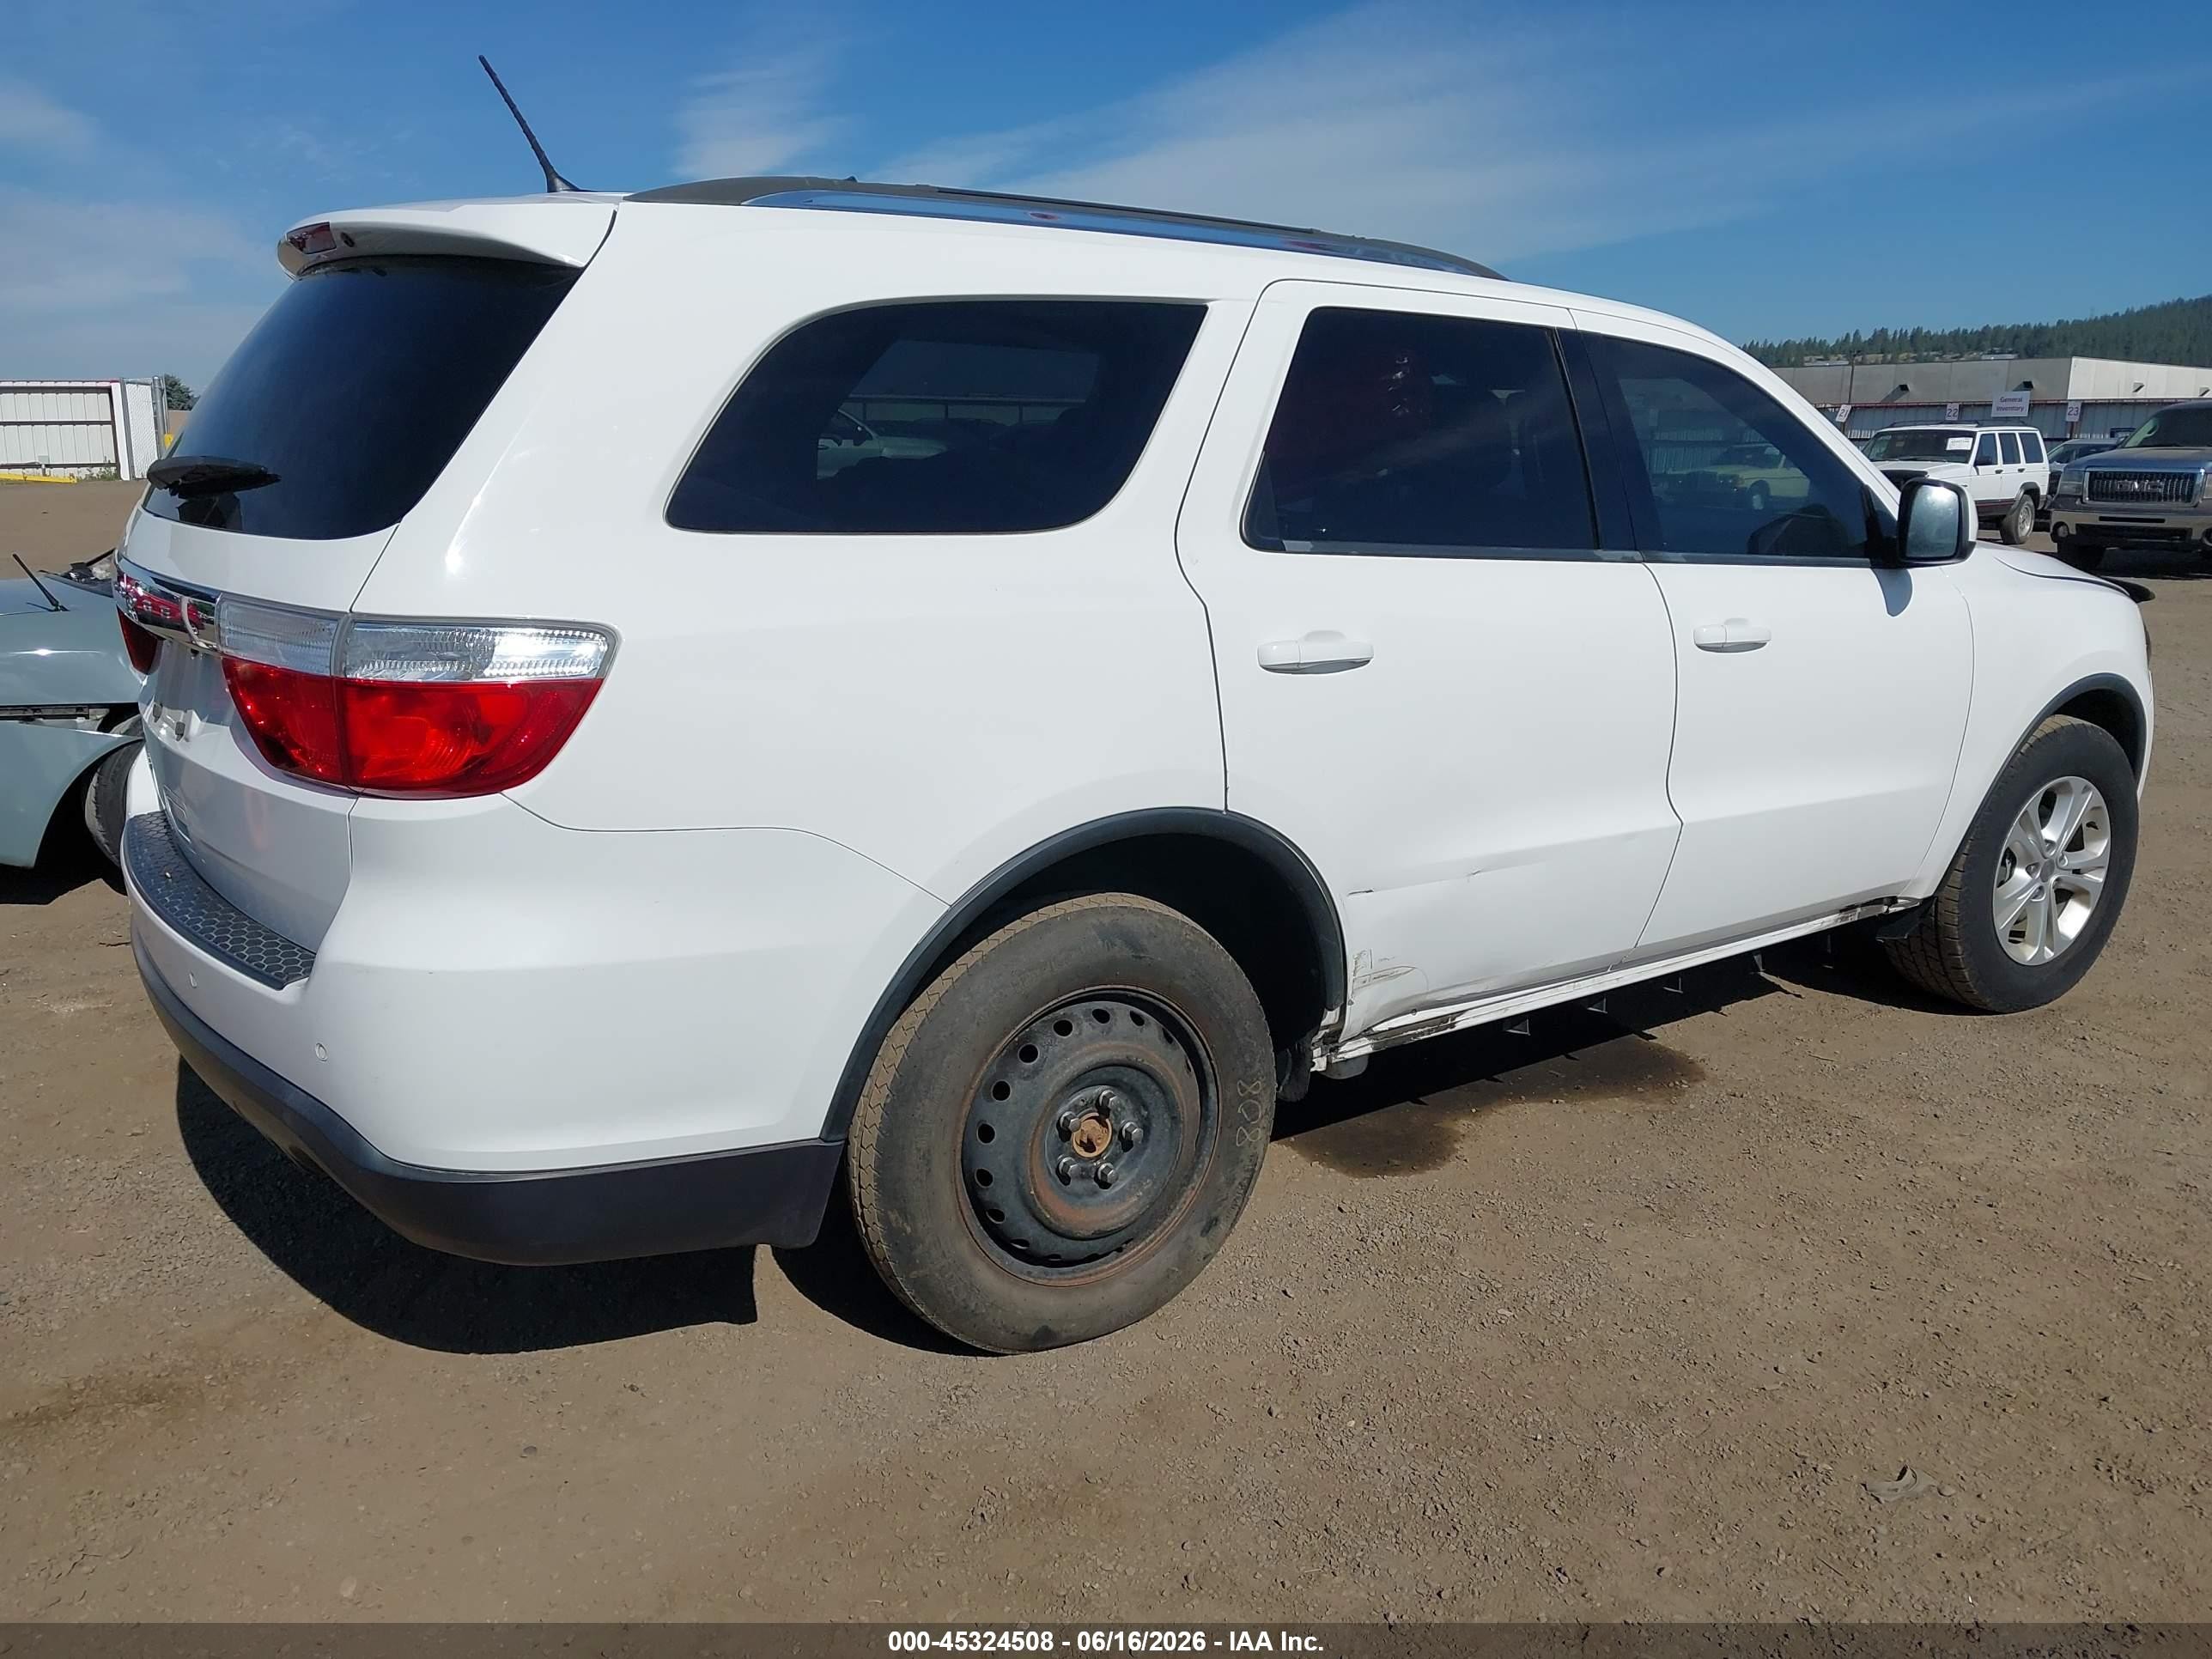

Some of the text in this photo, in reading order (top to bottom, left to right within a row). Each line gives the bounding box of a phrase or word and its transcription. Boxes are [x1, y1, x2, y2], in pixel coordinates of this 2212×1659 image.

[1838, 409, 1848, 417] 21
[1947, 408, 1959, 417] 22
[2068, 406, 2080, 416] 23
[2116, 480, 2165, 493] GMC
[1237, 1079, 1261, 1147] 808
